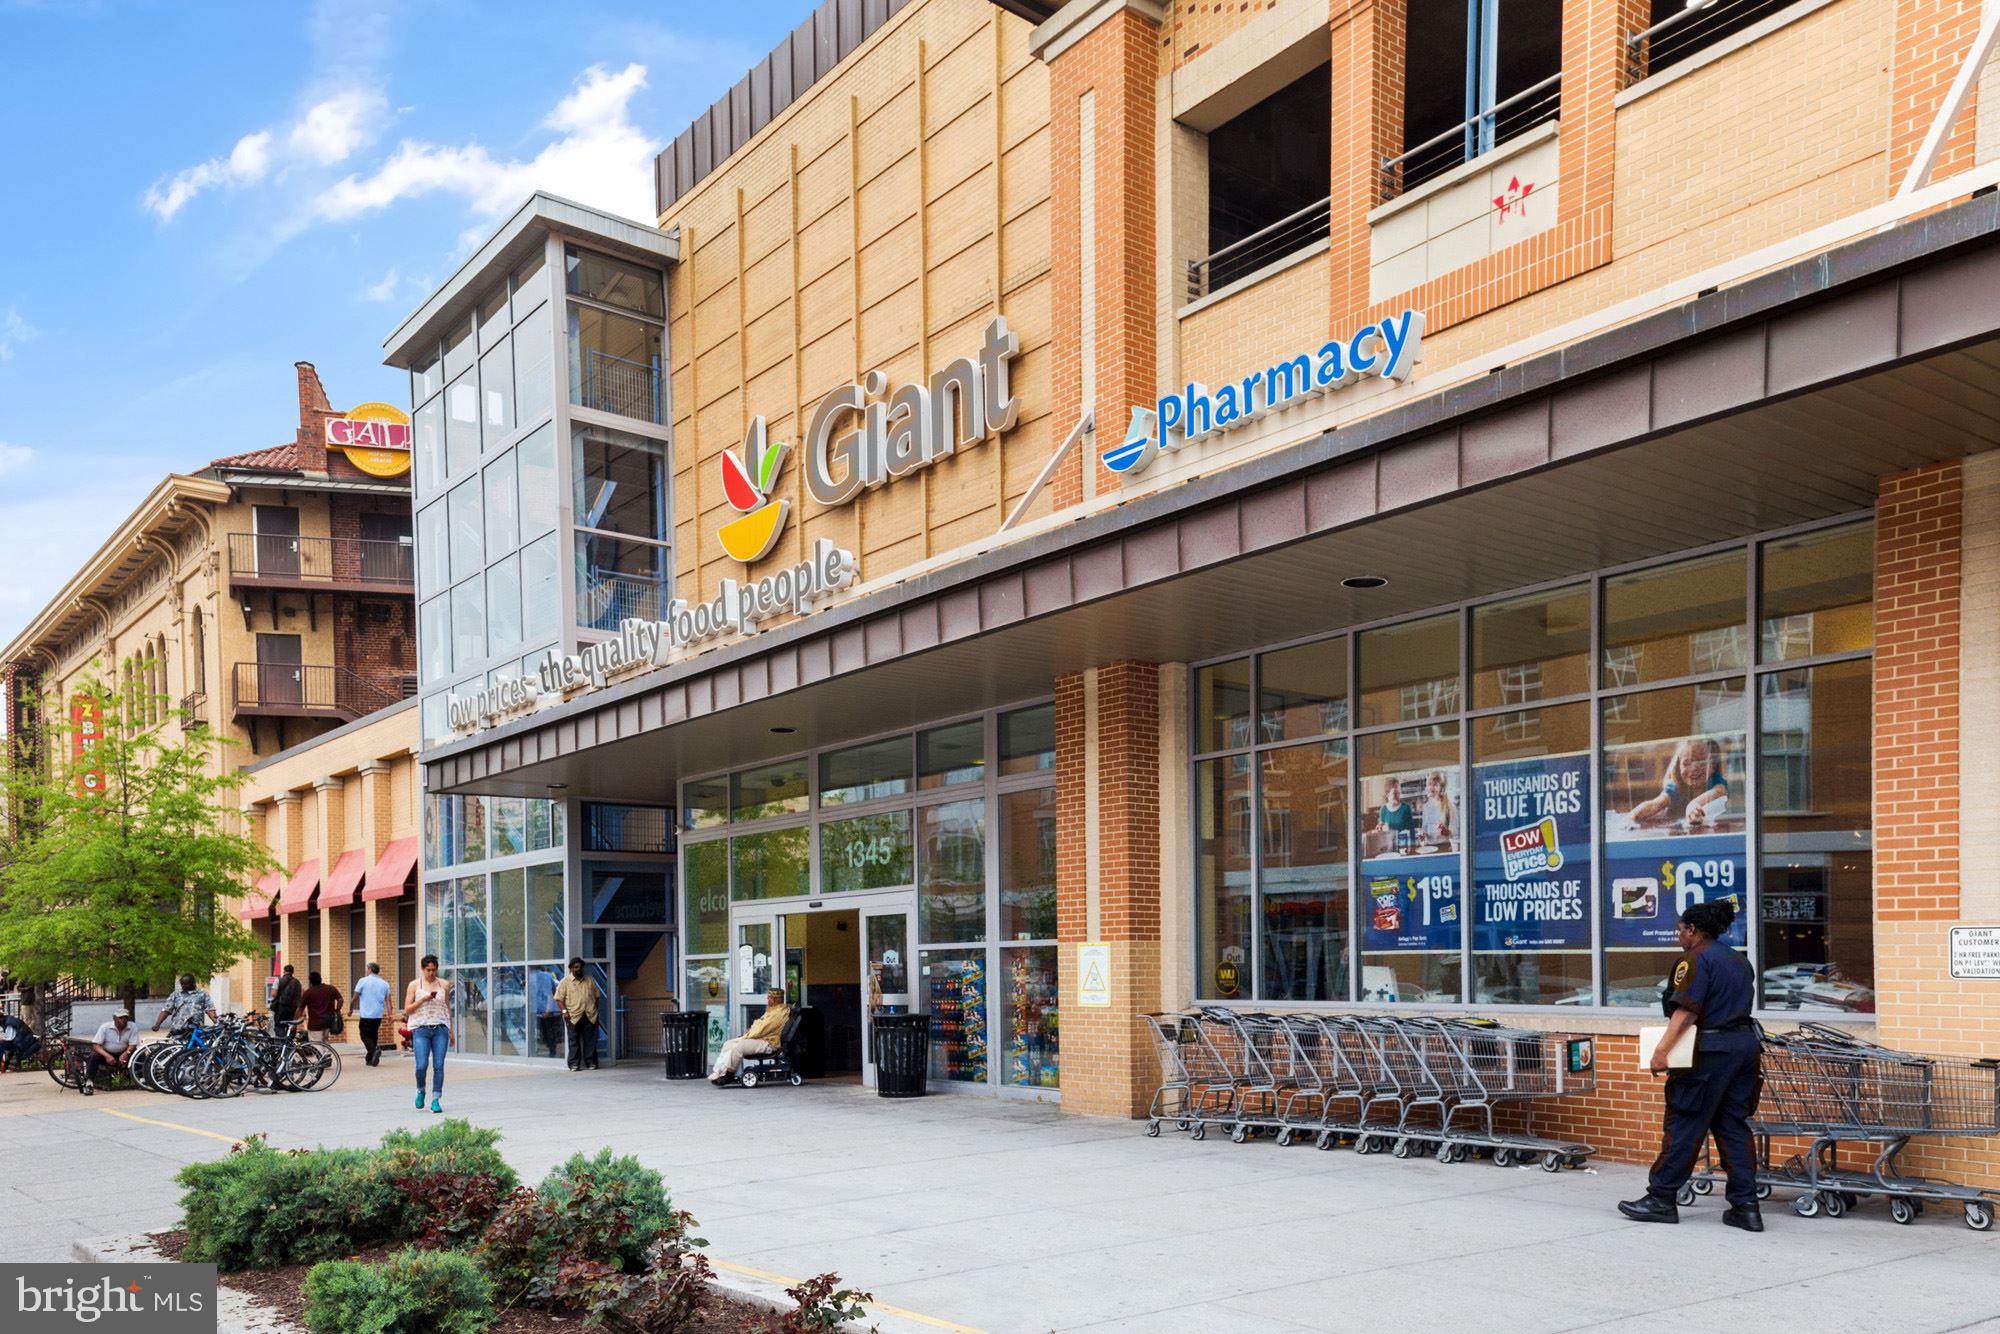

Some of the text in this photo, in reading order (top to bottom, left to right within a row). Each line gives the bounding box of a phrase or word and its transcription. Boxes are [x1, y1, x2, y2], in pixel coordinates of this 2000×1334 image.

[1157, 309, 1422, 449] Pharmacy
[803, 315, 1021, 506] Giant
[327, 419, 411, 449] GAL
[446, 538, 850, 729] low prices the quality food people
[81, 703, 94, 718] Z
[1483, 771, 1580, 797] THOUSANDS OF
[1484, 789, 1581, 821] BLUE TAGS
[1506, 828, 1540, 851] LOW
[845, 835, 892, 868] 1345
[1507, 844, 1544, 860] EVERYDAY
[1485, 879, 1581, 901] THOUSANDS OF
[1484, 898, 1583, 922] LOW PRICES
[1958, 938, 2000, 946] CUSTOMER
[1968, 930, 1993, 938] GIANT
[1953, 959, 1964, 967] ON
[1962, 967, 2000, 975] VALIDATION
